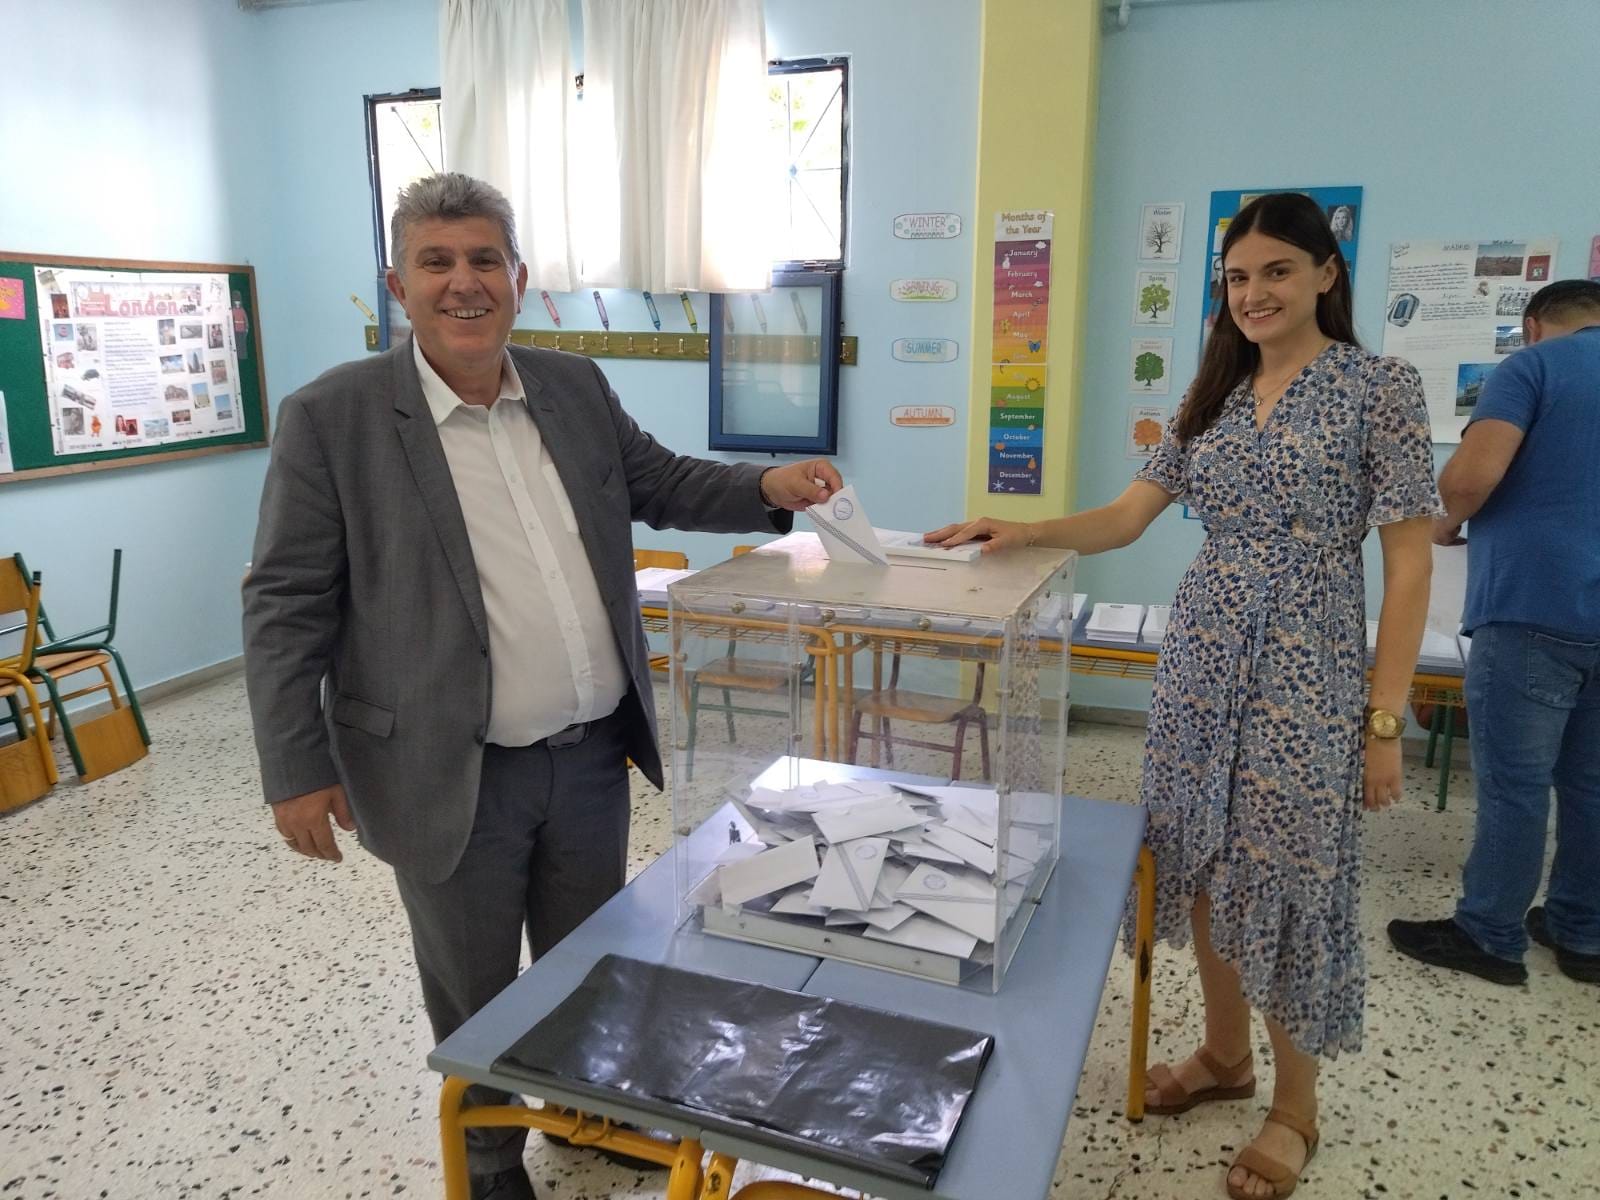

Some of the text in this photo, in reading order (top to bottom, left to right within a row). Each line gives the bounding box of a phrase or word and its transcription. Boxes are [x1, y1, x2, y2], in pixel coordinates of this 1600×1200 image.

[909, 215, 946, 228] WINTER
[1001, 211, 1048, 223] Months of
[1006, 224, 1041, 235] the Year
[1009, 249, 1038, 258] January
[1007, 270, 1038, 280] February
[1011, 290, 1033, 298] March
[906, 341, 942, 354] SUMMER
[904, 407, 943, 418] AUTUMN
[1000, 412, 1035, 421] September
